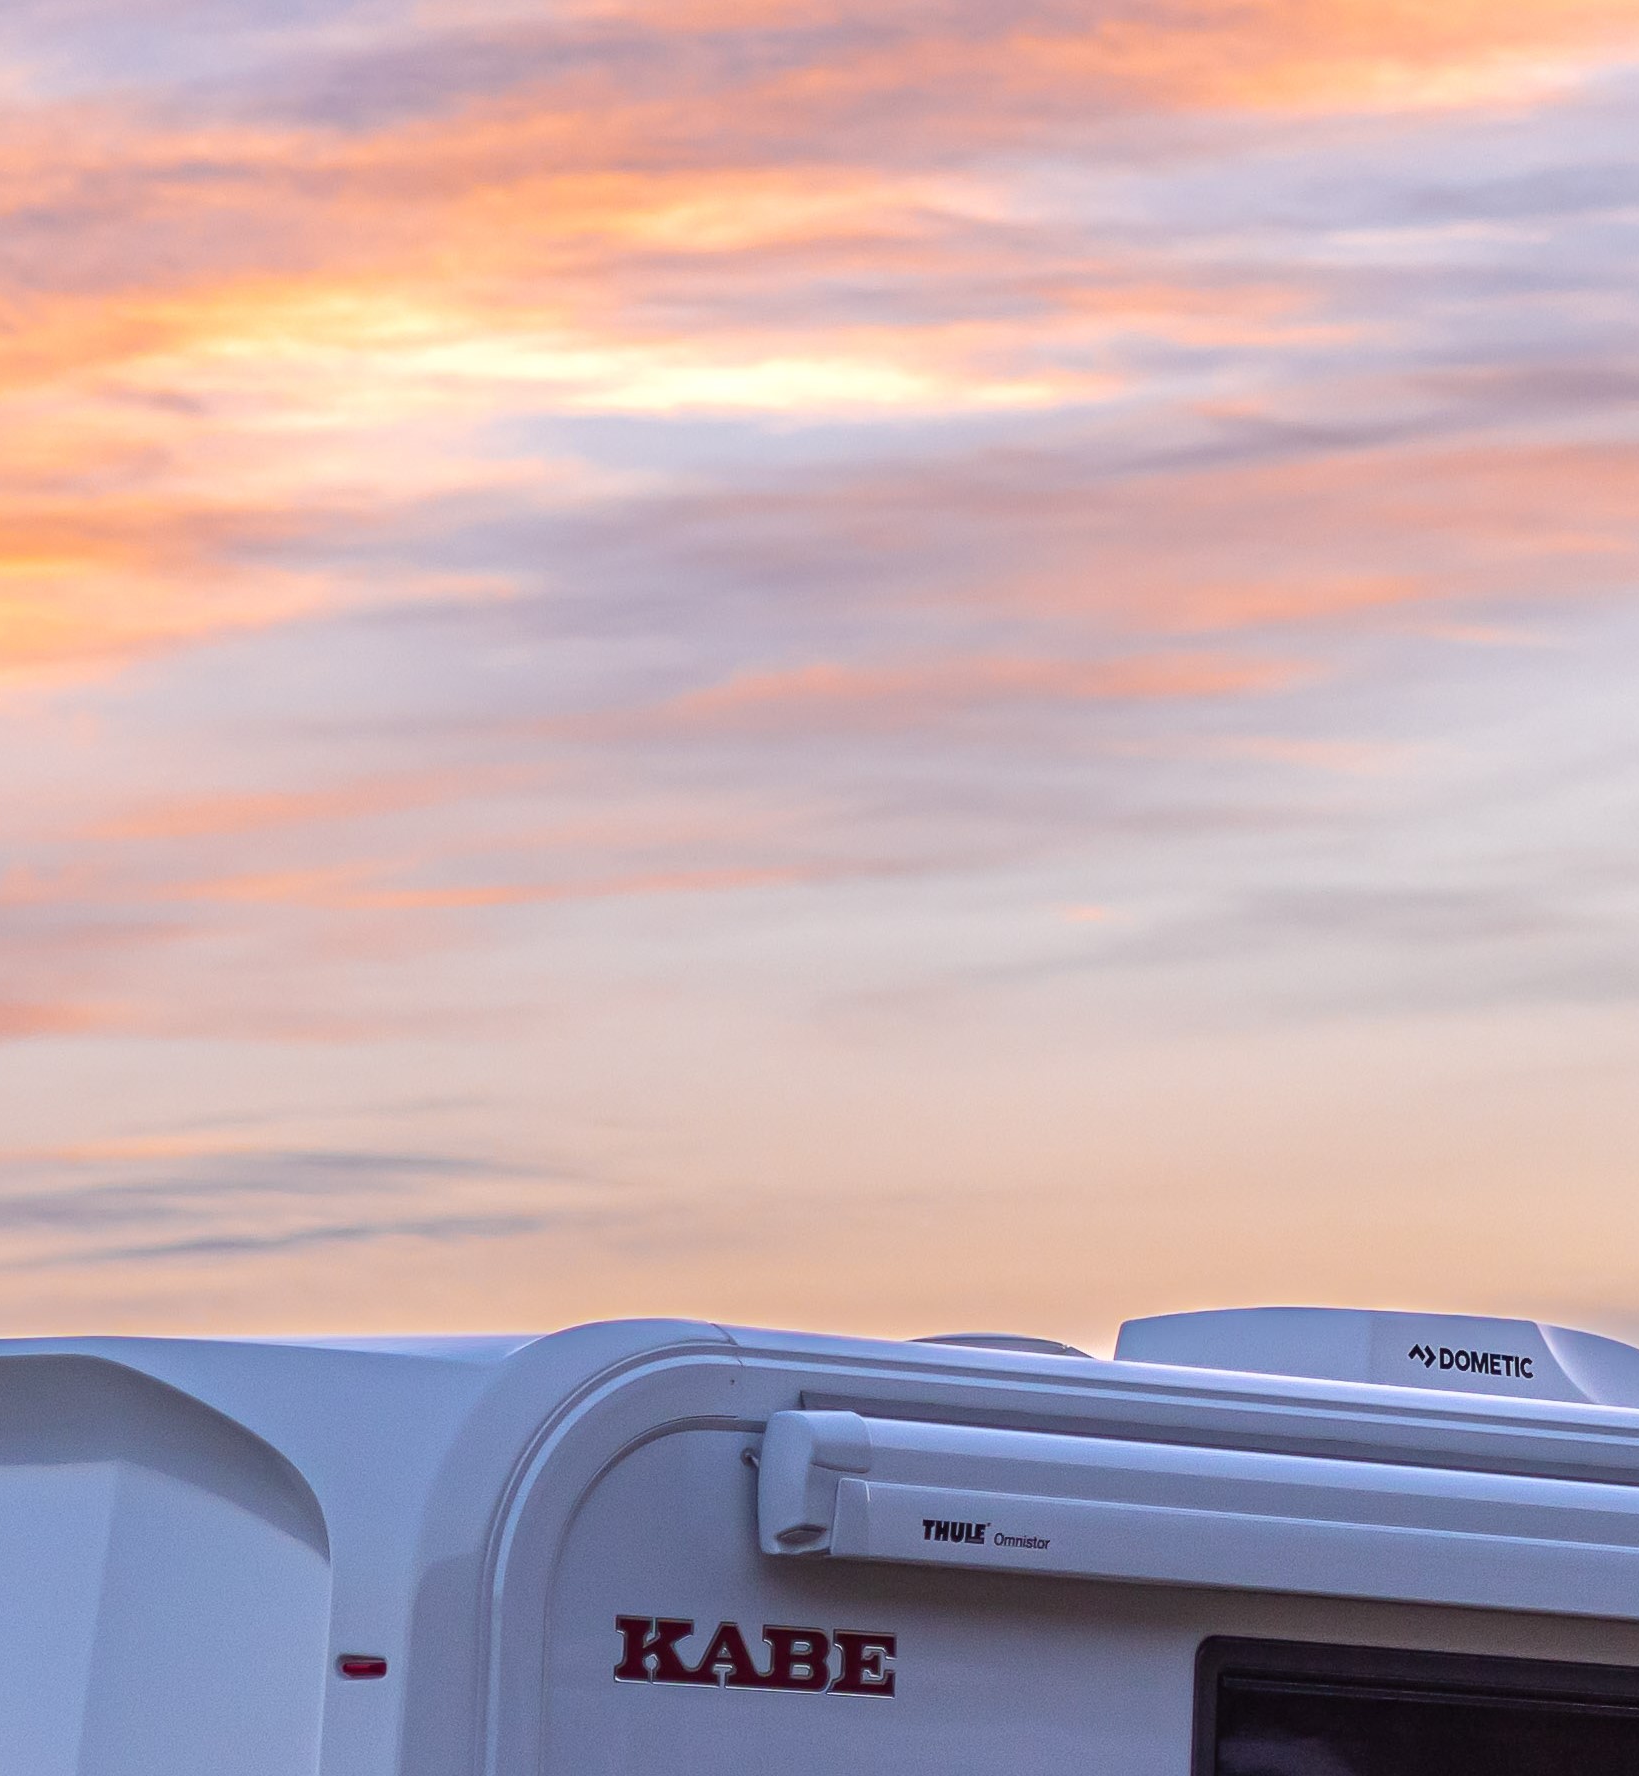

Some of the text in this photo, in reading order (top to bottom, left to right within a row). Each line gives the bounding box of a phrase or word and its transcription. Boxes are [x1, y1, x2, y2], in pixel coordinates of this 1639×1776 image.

[1439, 1347, 1534, 1379] DOMETIC
[922, 1519, 1050, 1550] THULE Omnistor
[613, 1614, 898, 1699] KABE
